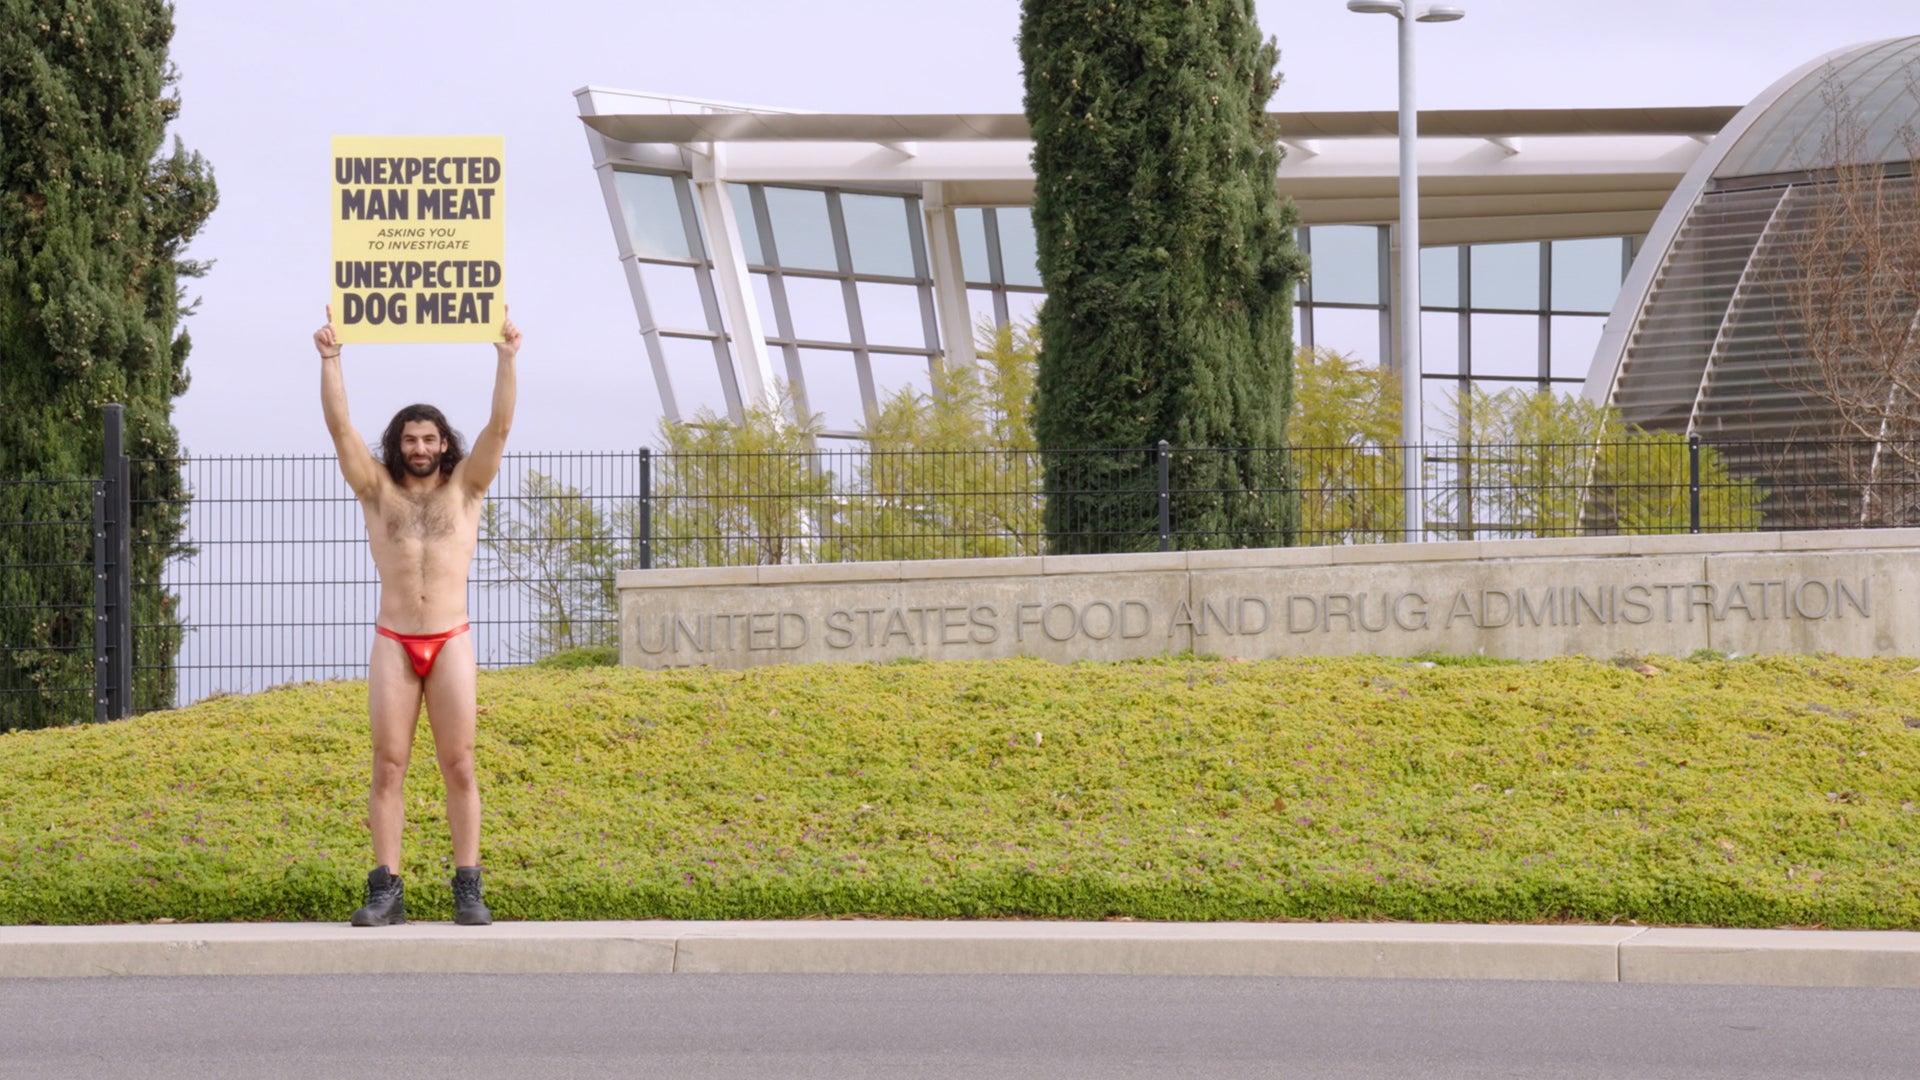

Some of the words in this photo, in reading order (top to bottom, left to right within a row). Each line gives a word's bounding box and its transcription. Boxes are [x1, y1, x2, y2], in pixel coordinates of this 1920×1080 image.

[335, 157, 501, 184] UNEXPECTED
[341, 188, 409, 220] MAN
[417, 188, 495, 220] MEAT
[368, 240, 384, 250] TO
[387, 240, 470, 250] INVESTIGATE
[377, 228, 426, 237] ASKING
[429, 228, 456, 237] YOU
[335, 260, 502, 288] UNEXPECTED
[343, 292, 408, 325] DOG
[415, 292, 494, 324] MEAT
[637, 612, 810, 654] UNITED
[826, 603, 1001, 648] STATES
[1016, 600, 1153, 641] FOOD
[1168, 596, 1272, 637] AND
[1287, 591, 1430, 634] DRUG
[1447, 577, 1871, 628] ADMINISTRATION
